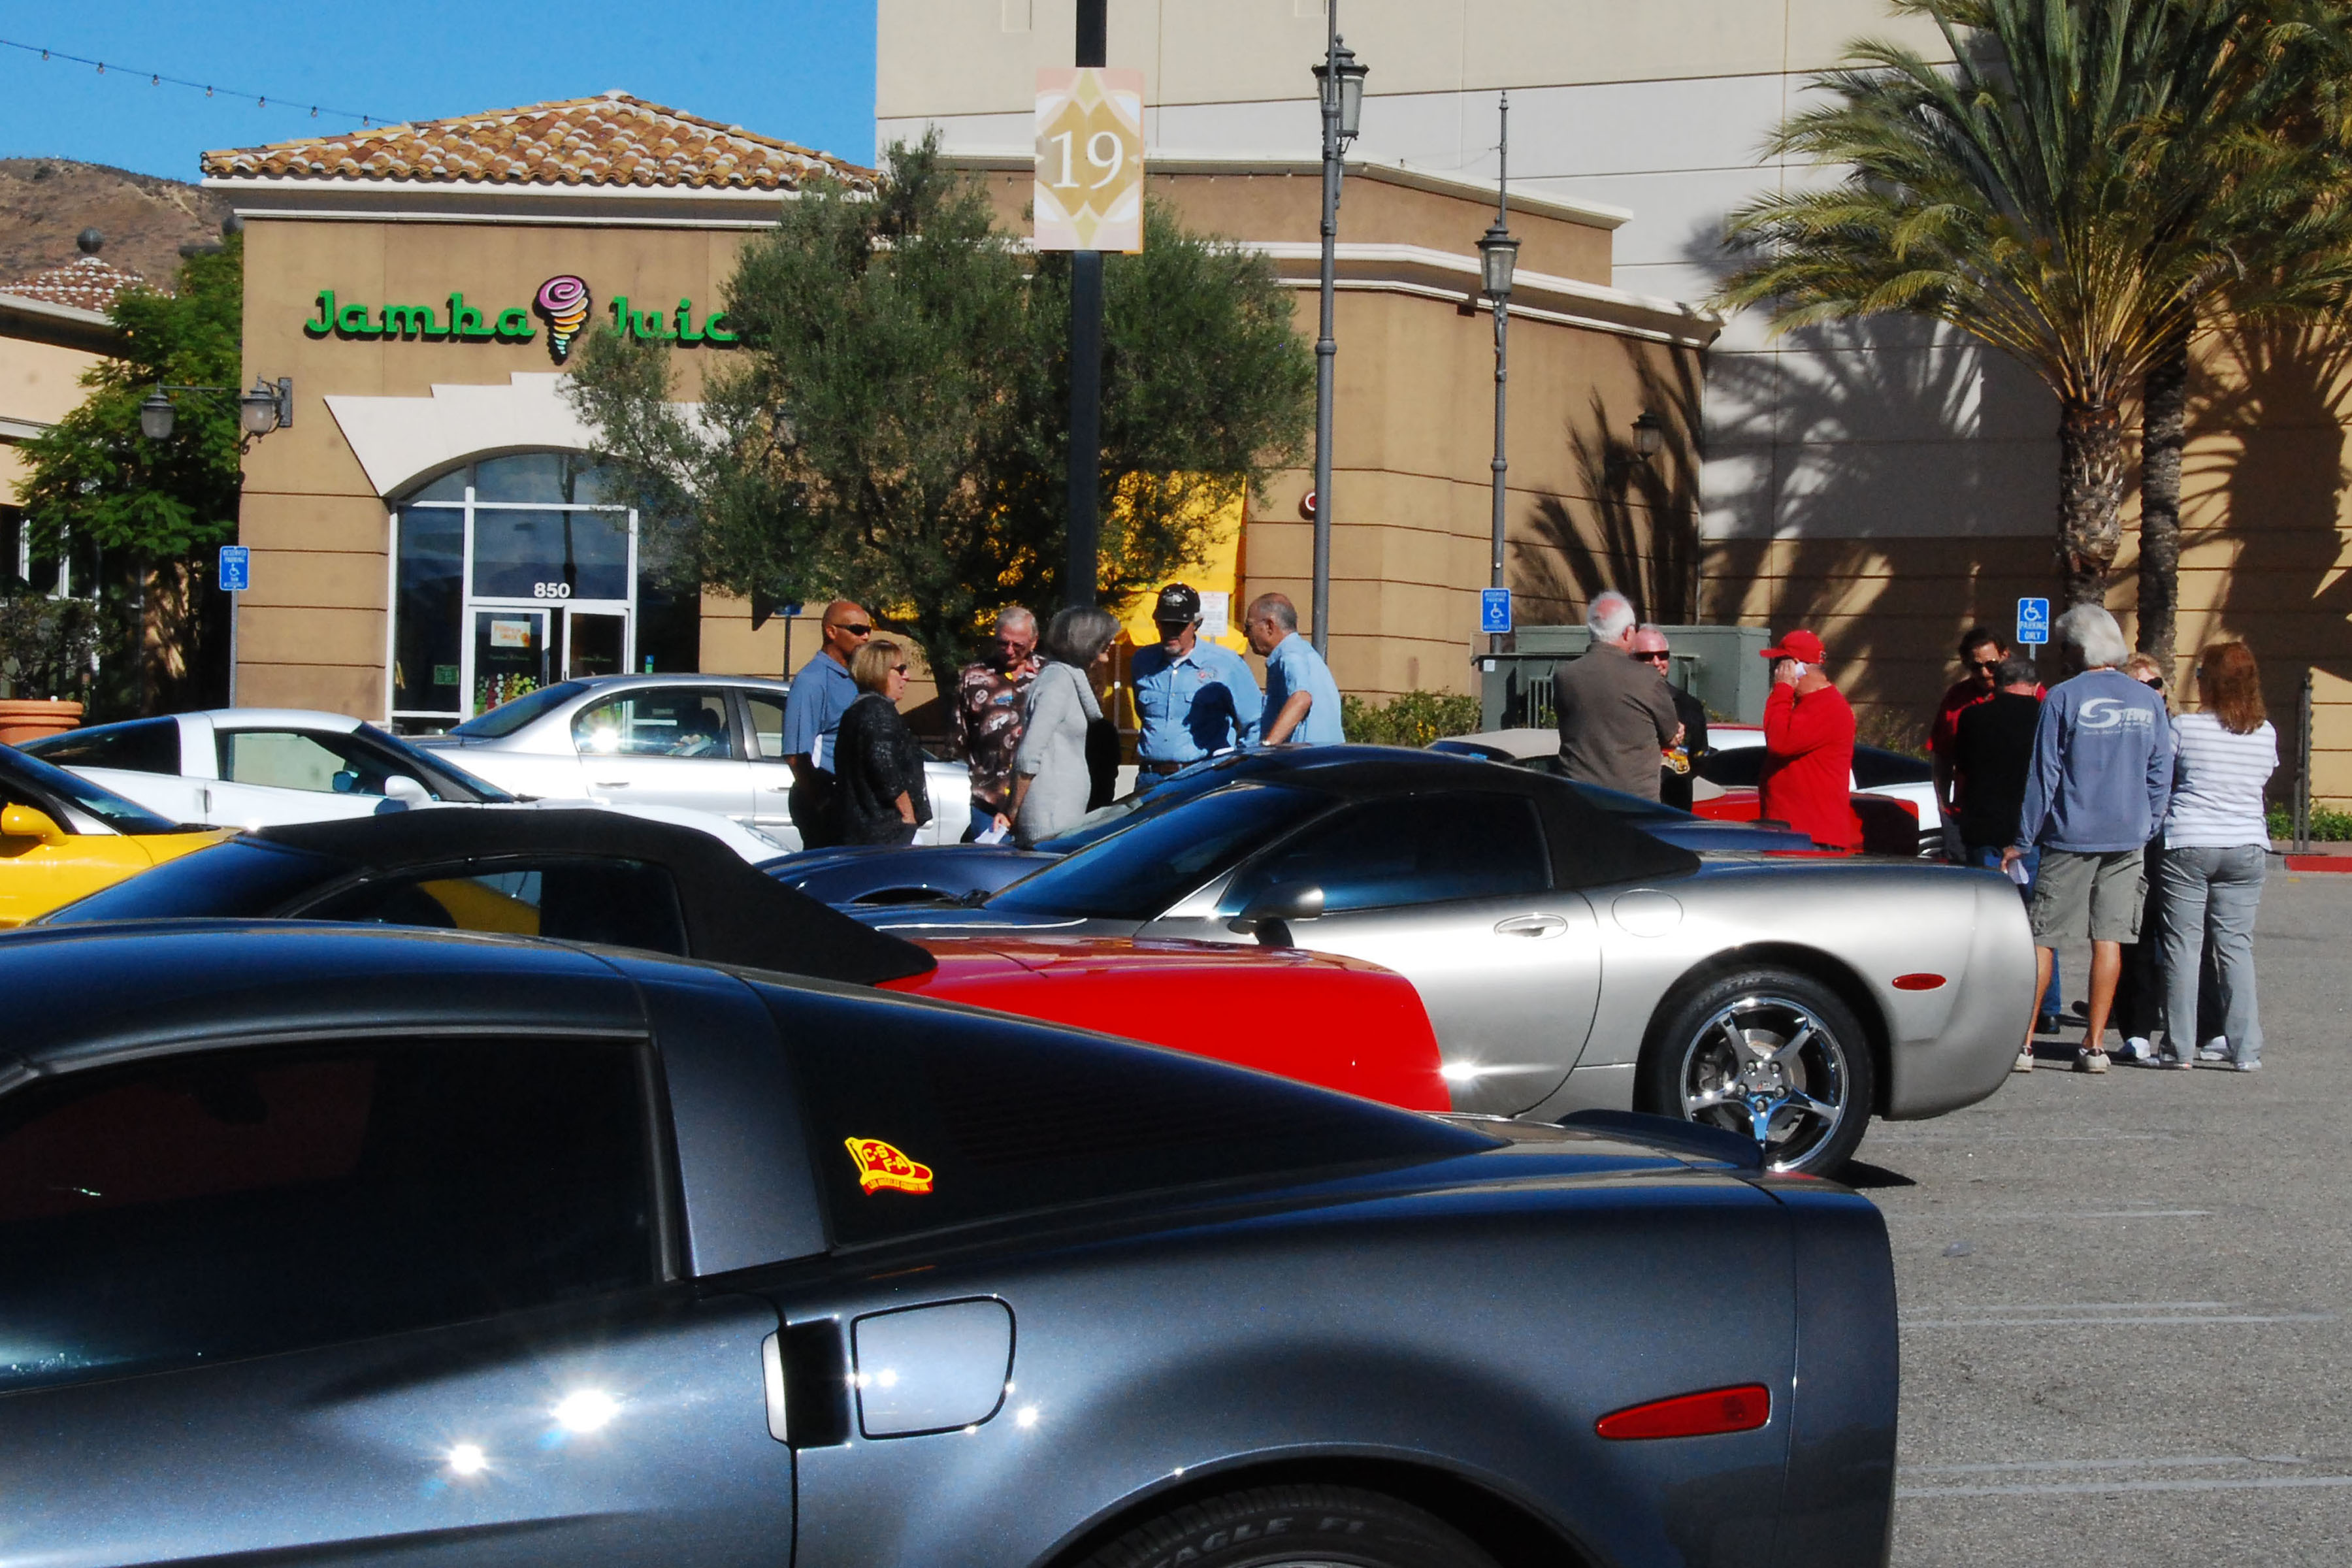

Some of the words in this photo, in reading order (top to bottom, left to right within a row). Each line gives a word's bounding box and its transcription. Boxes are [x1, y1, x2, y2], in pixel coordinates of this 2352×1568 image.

[1050, 130, 1124, 190] 19
[305, 289, 536, 338] Jamba
[606, 295, 771, 342] Juic
[534, 581, 570, 598] 850
[2018, 621, 2048, 630] PARKING
[2024, 630, 2042, 640] ONLY
